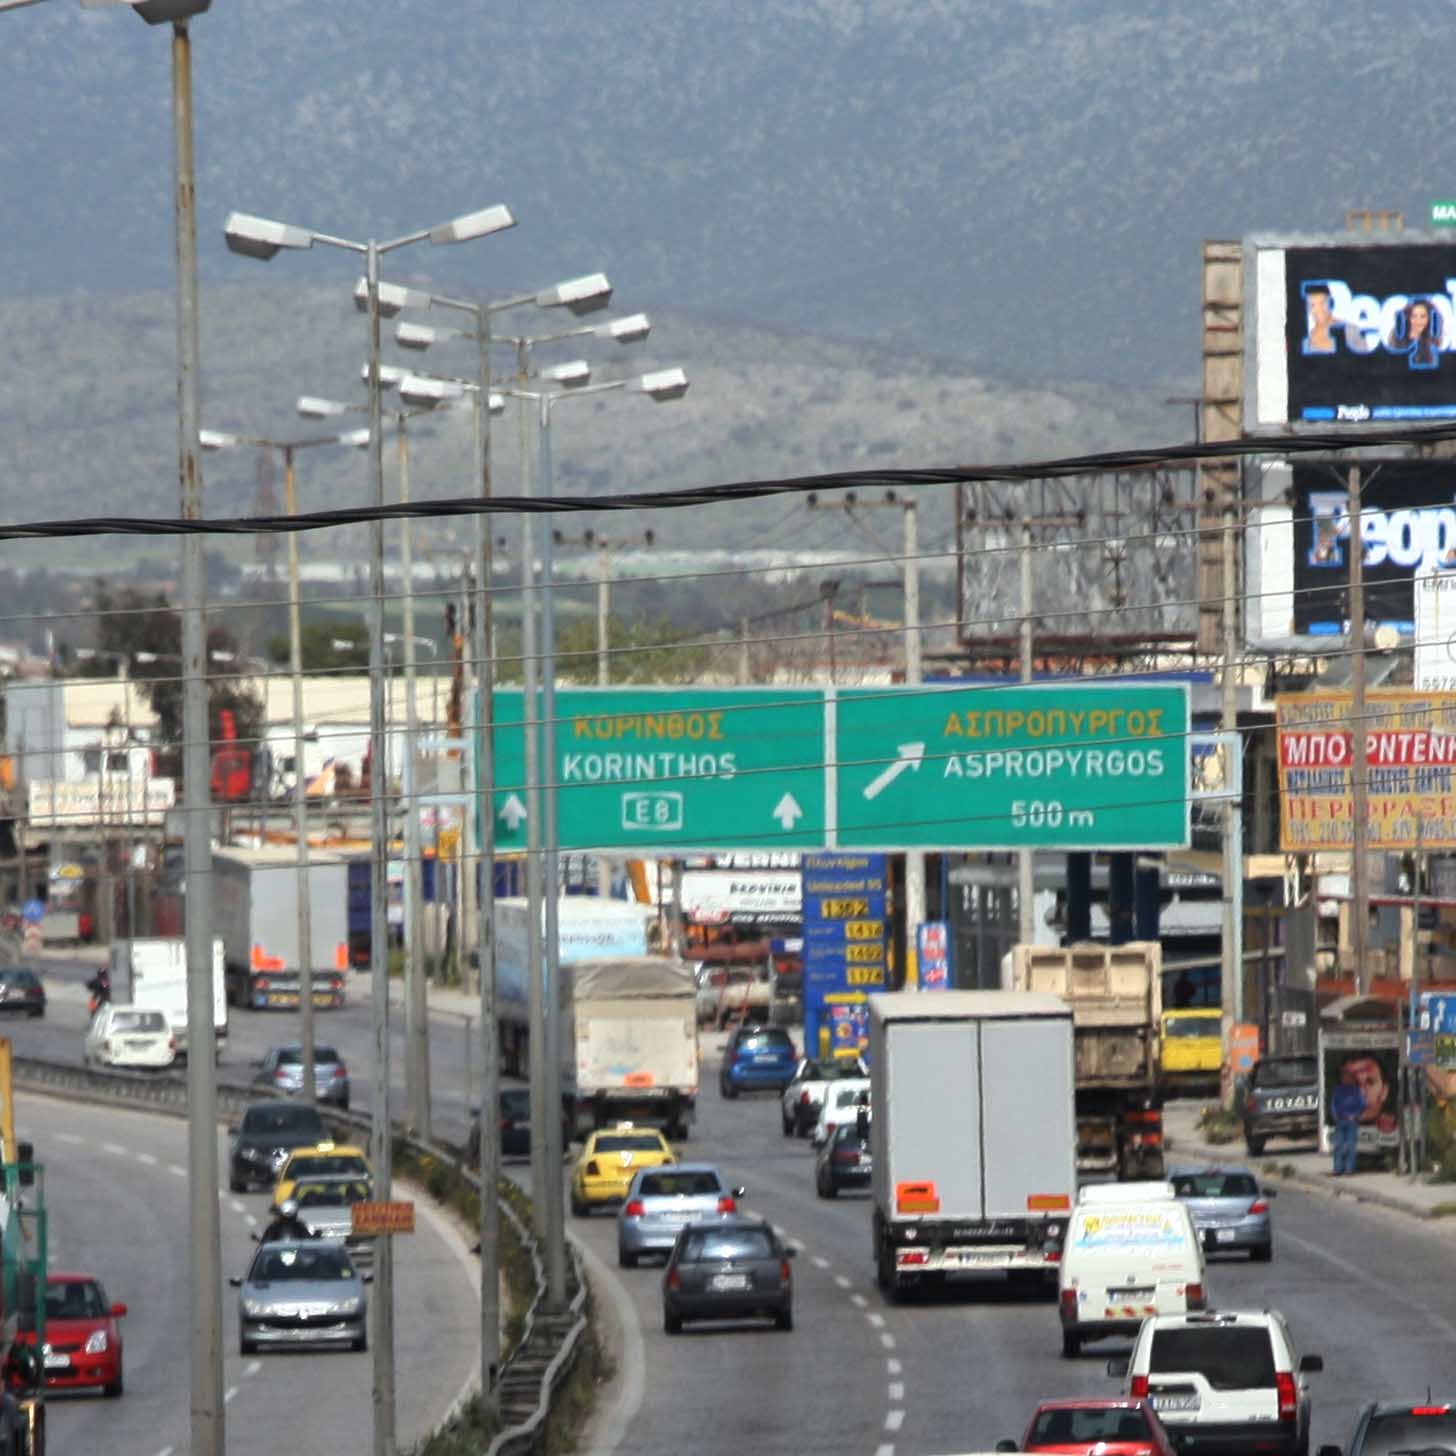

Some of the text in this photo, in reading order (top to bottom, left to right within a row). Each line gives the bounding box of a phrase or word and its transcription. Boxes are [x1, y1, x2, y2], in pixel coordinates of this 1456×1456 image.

[573, 712, 725, 740] ΚΟΡΙΝΘΟΣ
[943, 708, 1164, 738] ΑΣΠΡΟΠΥΡΓΟΣ
[562, 752, 738, 780] KORINTHOS
[943, 749, 1165, 778] ASPROPYRGOS
[1011, 800, 1094, 828] 500 m
